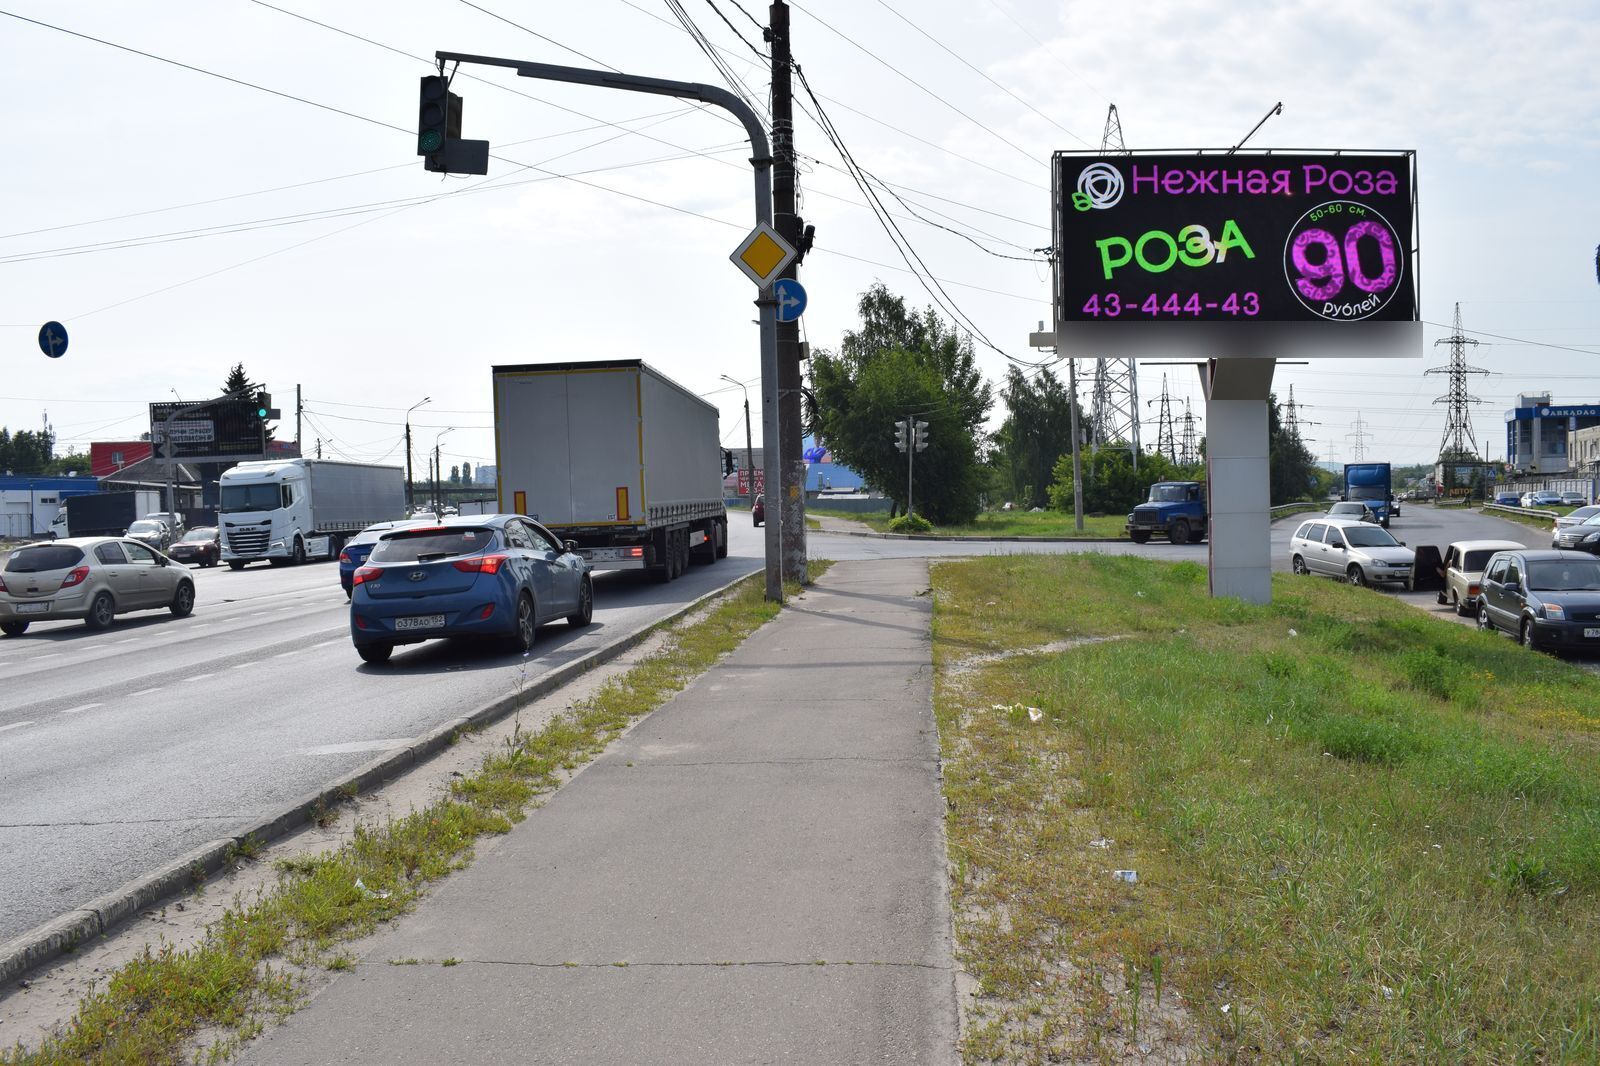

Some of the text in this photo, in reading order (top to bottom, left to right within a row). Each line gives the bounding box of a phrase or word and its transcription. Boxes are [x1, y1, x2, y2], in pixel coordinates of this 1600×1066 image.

[1132, 164, 1398, 195] Нежная Роза
[1309, 203, 1343, 222] 50-60
[1095, 219, 1256, 280] РОЗА
[1292, 221, 1397, 301] 90
[1082, 292, 1260, 317] 43-444-43
